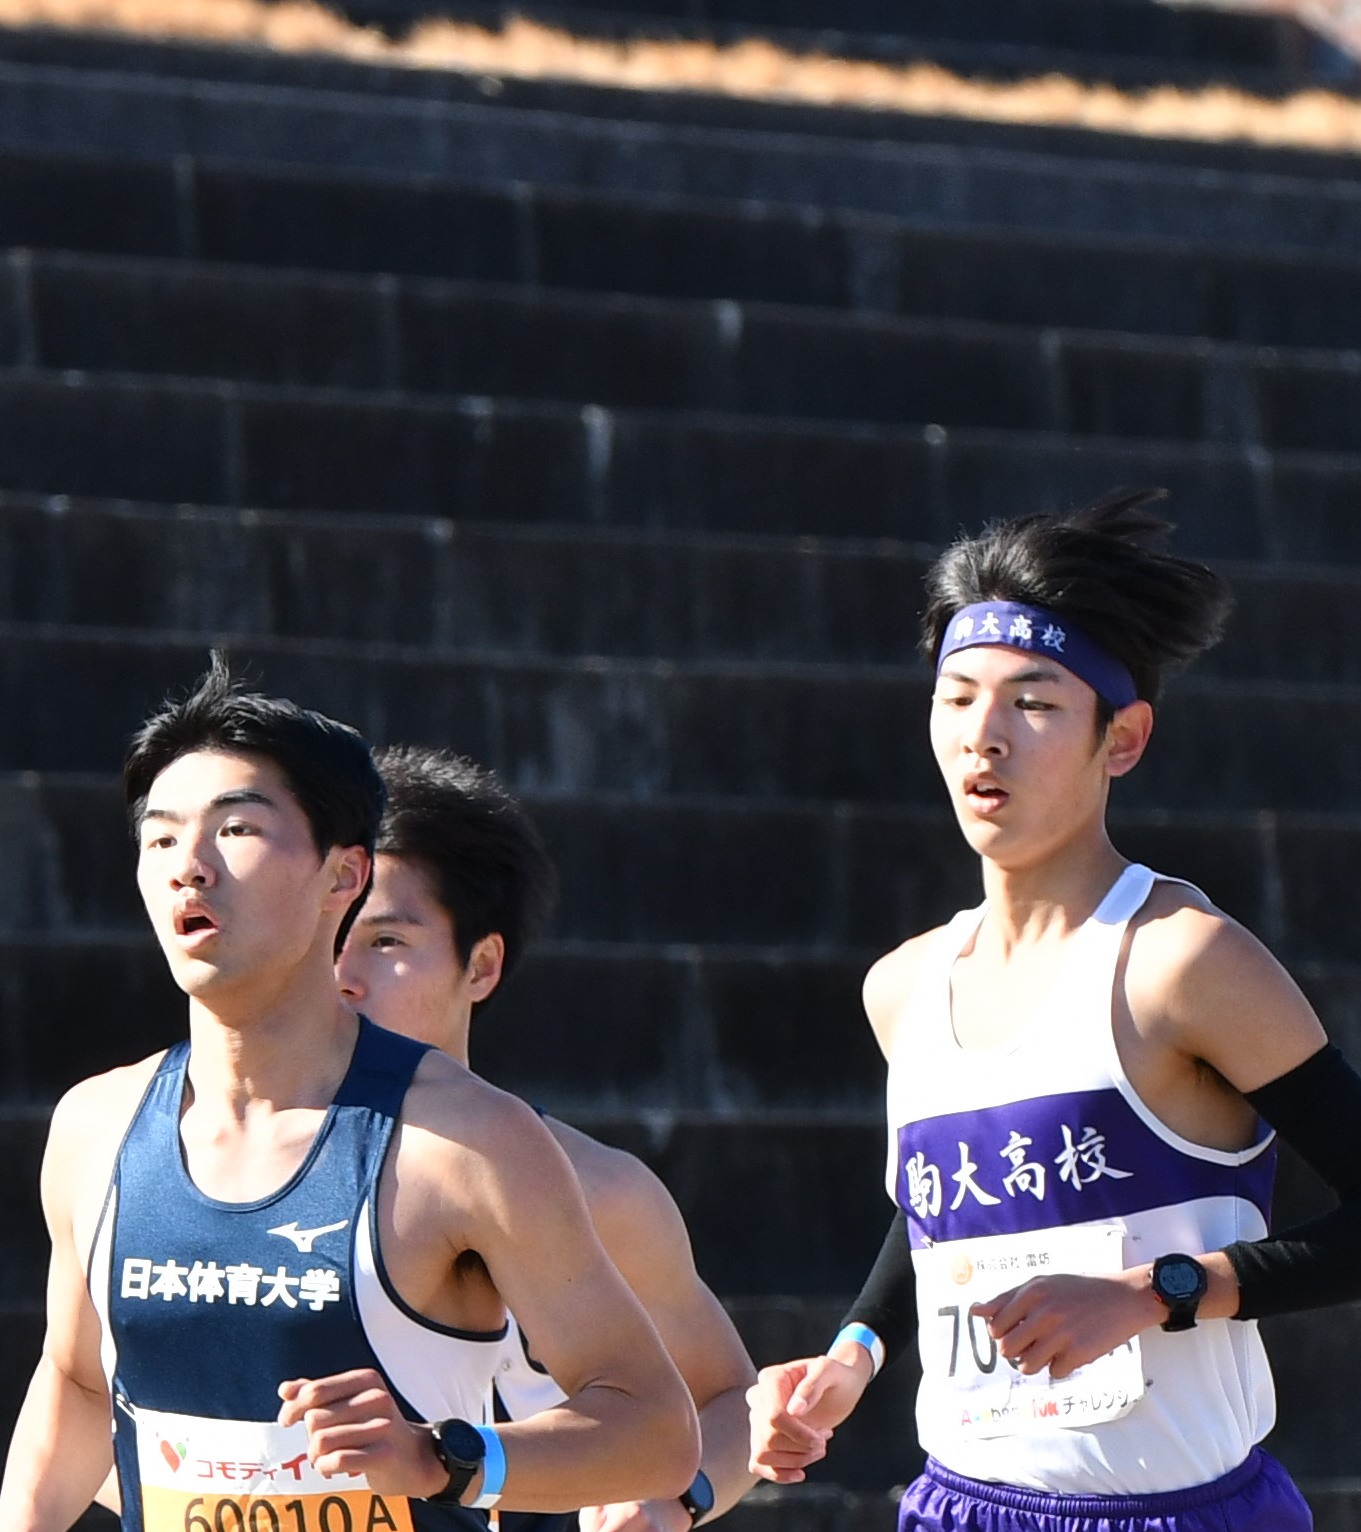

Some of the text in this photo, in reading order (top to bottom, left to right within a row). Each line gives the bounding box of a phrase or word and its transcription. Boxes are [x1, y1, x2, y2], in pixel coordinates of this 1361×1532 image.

[905, 1124, 1135, 1219] 駒大高校
[120, 1258, 340, 1311] 日本体育大学
[196, 1453, 364, 1481] コモディイ
